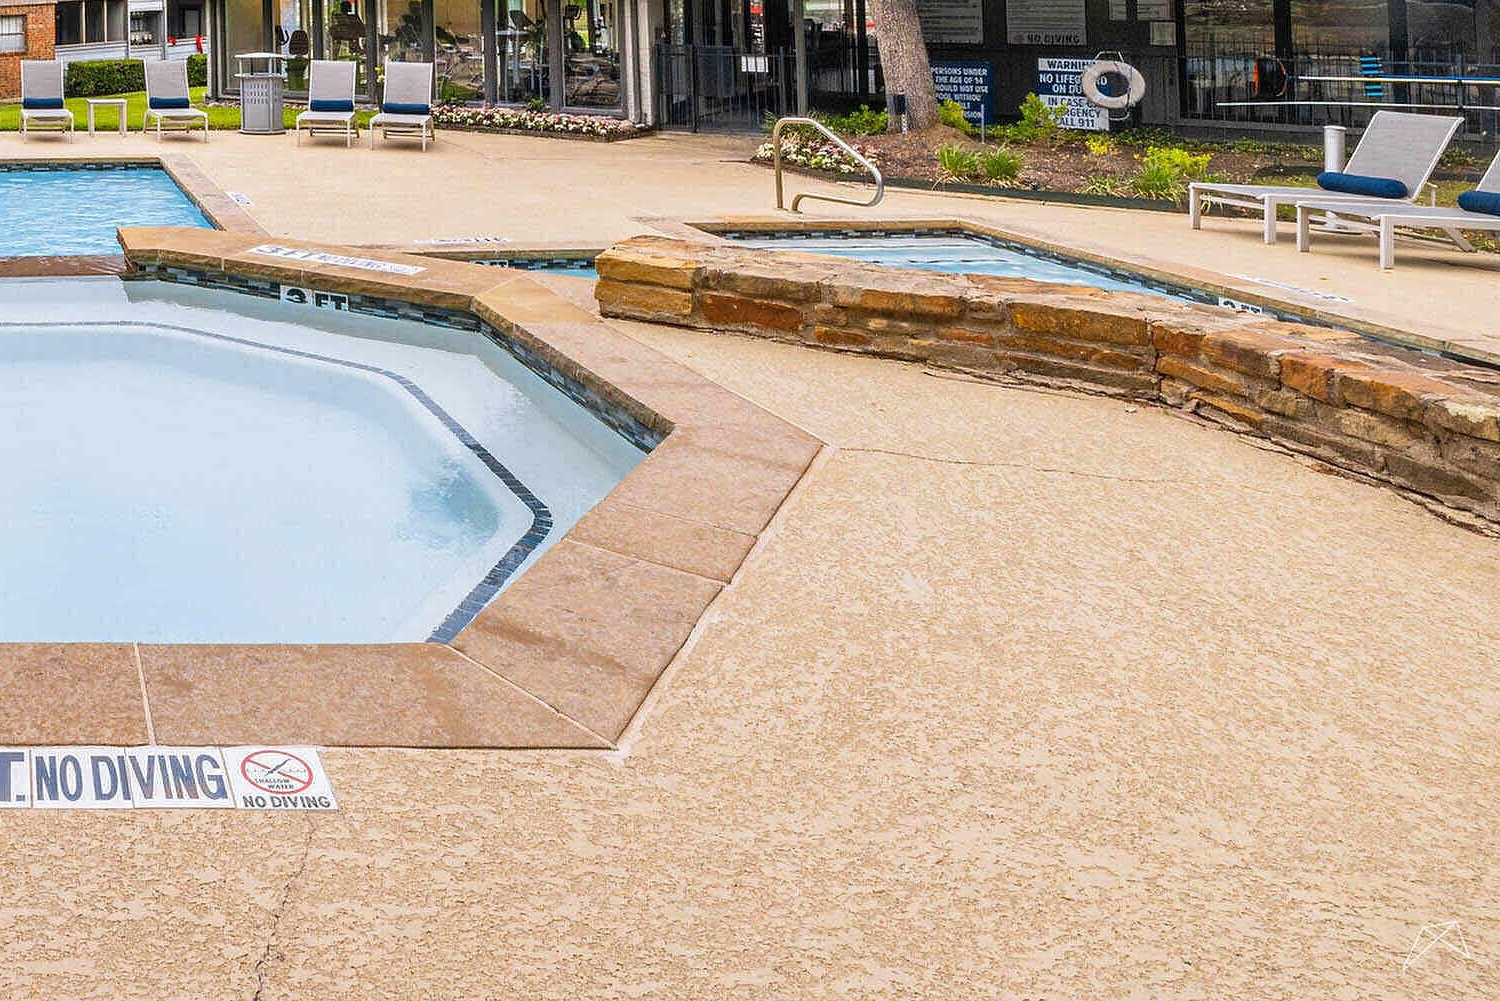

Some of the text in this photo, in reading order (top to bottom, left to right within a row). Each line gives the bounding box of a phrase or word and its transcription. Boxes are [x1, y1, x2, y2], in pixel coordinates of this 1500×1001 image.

[1044, 32, 1081, 44] DIVING
[1047, 60, 1096, 69] WARNIN
[963, 67, 987, 76] UNDER
[935, 75, 949, 83] THE
[950, 76, 962, 84] AGE
[1040, 73, 1053, 83] NO
[934, 84, 959, 92] HOULD
[975, 85, 989, 93] USE
[1052, 84, 1067, 93] ON
[1048, 97, 1058, 105] IN
[1061, 97, 1084, 107] CASE
[1078, 119, 1095, 128] 911
[286, 287, 308, 304] 3
[36, 755, 83, 801] NO
[91, 755, 229, 801] DIVING
[243, 795, 331, 809] NO DIVING
